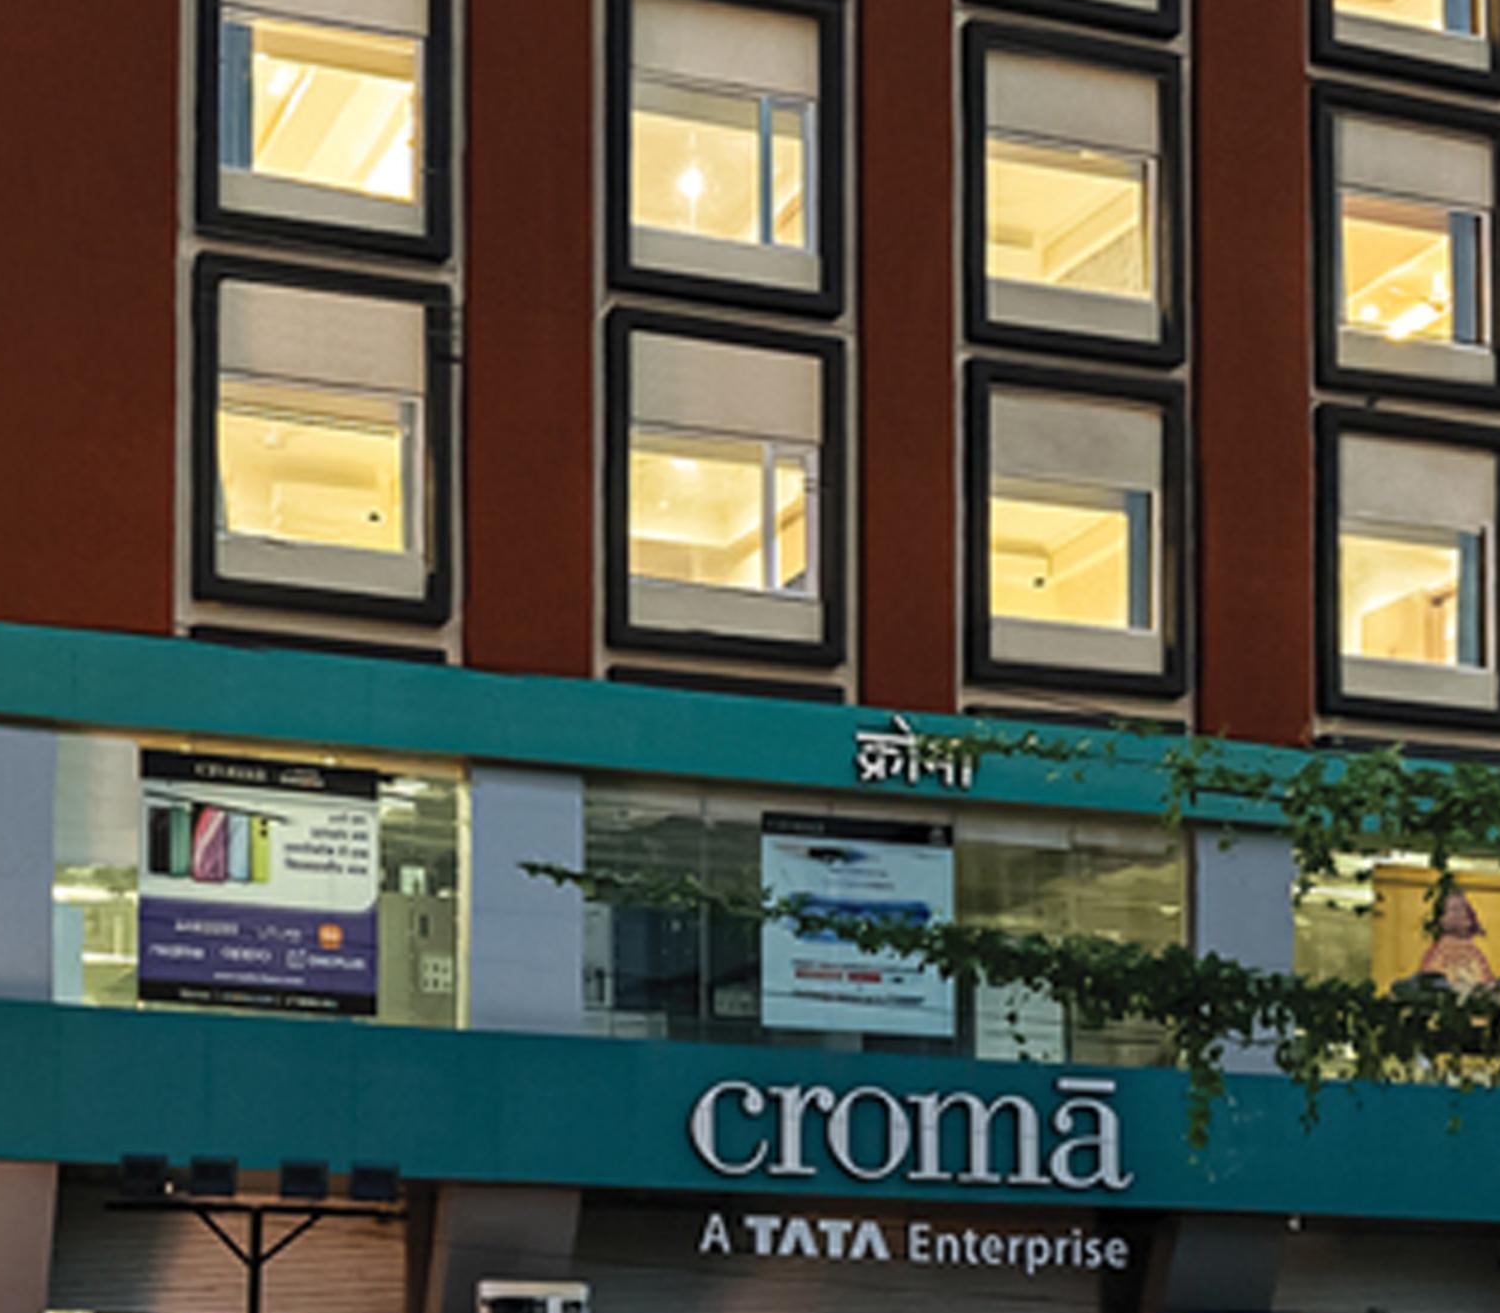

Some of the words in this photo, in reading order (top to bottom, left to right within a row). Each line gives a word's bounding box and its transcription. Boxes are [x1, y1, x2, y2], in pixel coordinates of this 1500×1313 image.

[691, 1078, 1132, 1189] cromā
[700, 1214, 731, 1254] A
[744, 1215, 890, 1259] TATA
[908, 1224, 1129, 1274] Enterprise
